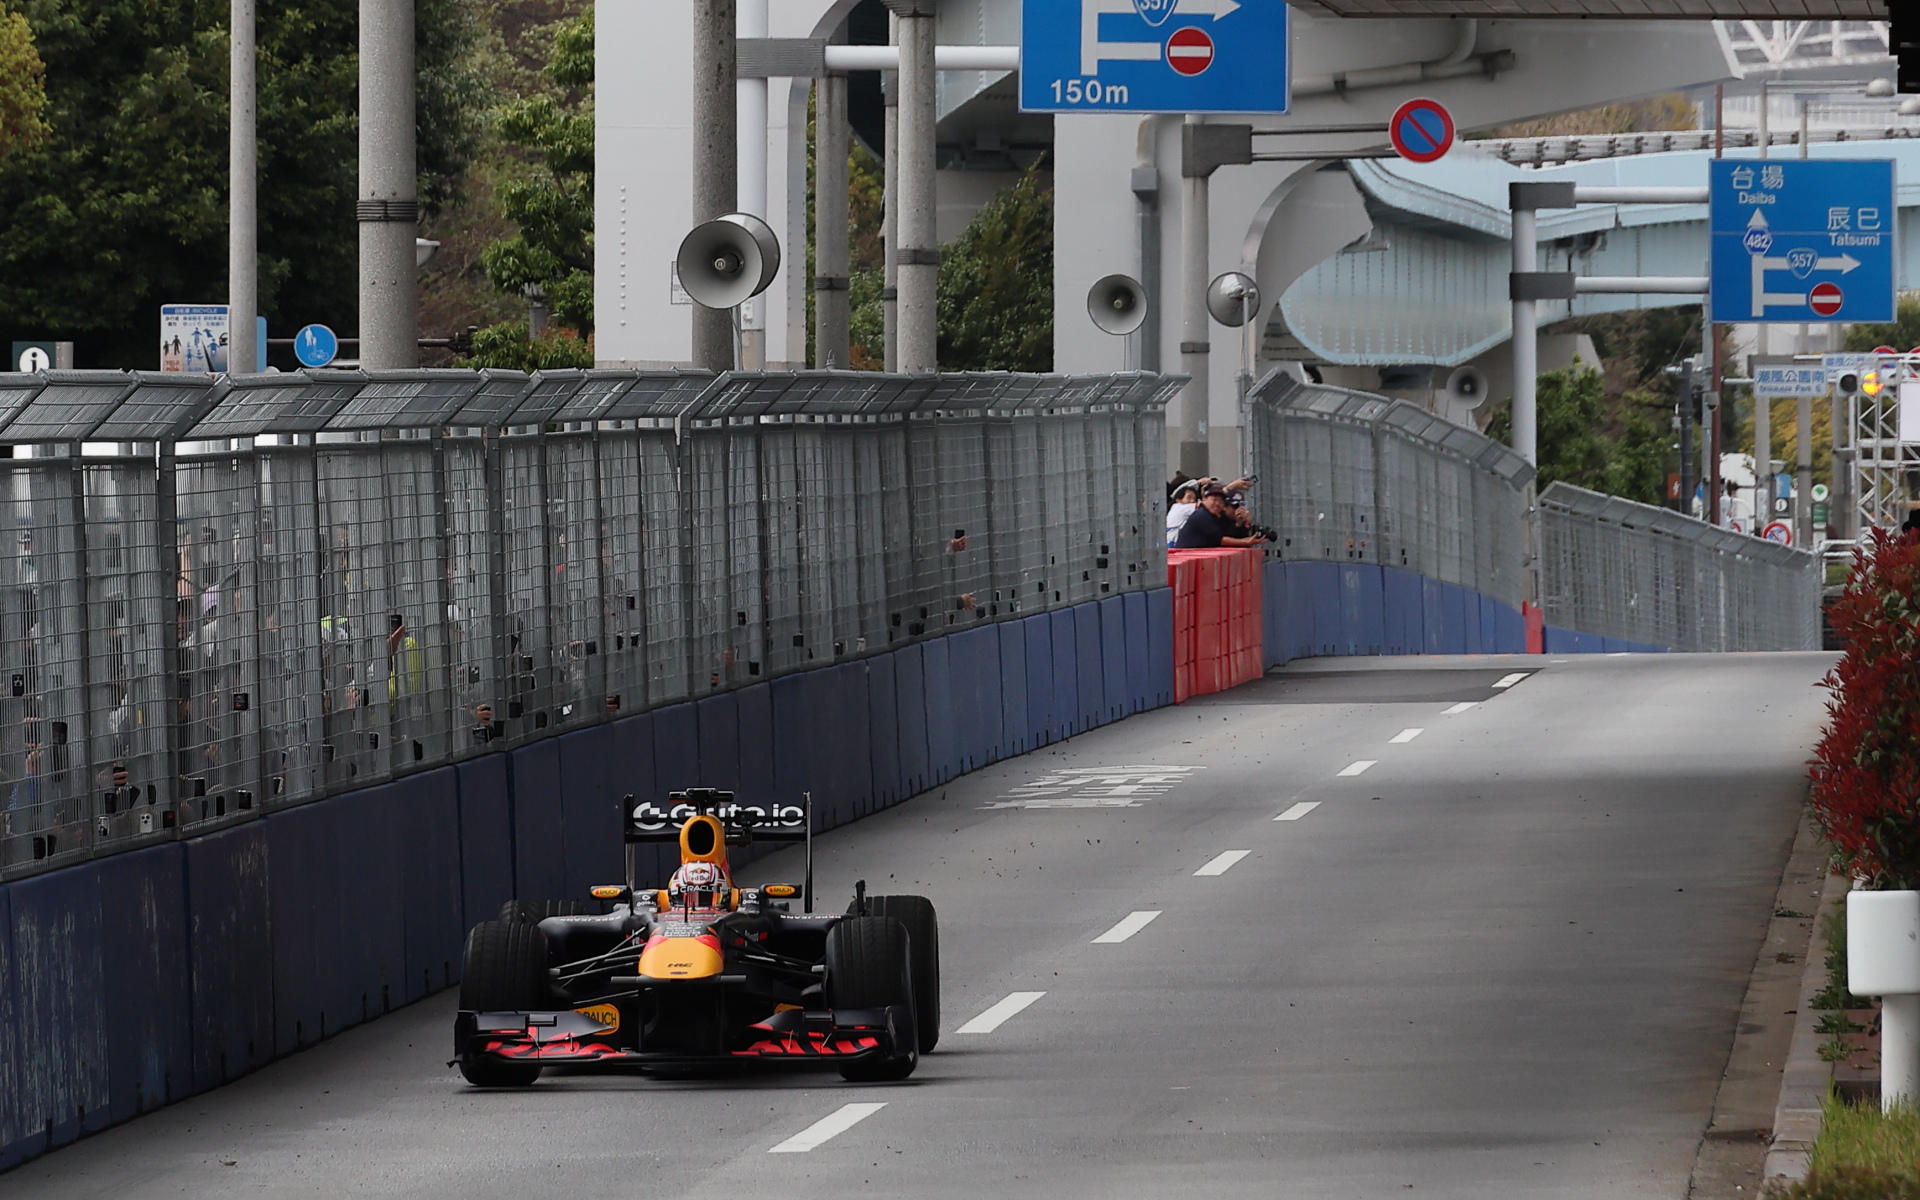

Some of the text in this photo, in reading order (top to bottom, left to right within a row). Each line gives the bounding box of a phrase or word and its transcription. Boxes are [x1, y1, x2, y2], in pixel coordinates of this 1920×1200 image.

[1050, 79, 1129, 104] 150m
[1731, 164, 1784, 190] 台場
[1738, 191, 1776, 205] Daiba
[1826, 206, 1881, 230] 辰巳
[1746, 233, 1769, 248] 482
[1828, 232, 1880, 246] Tatsumi
[1791, 253, 1813, 268] 357
